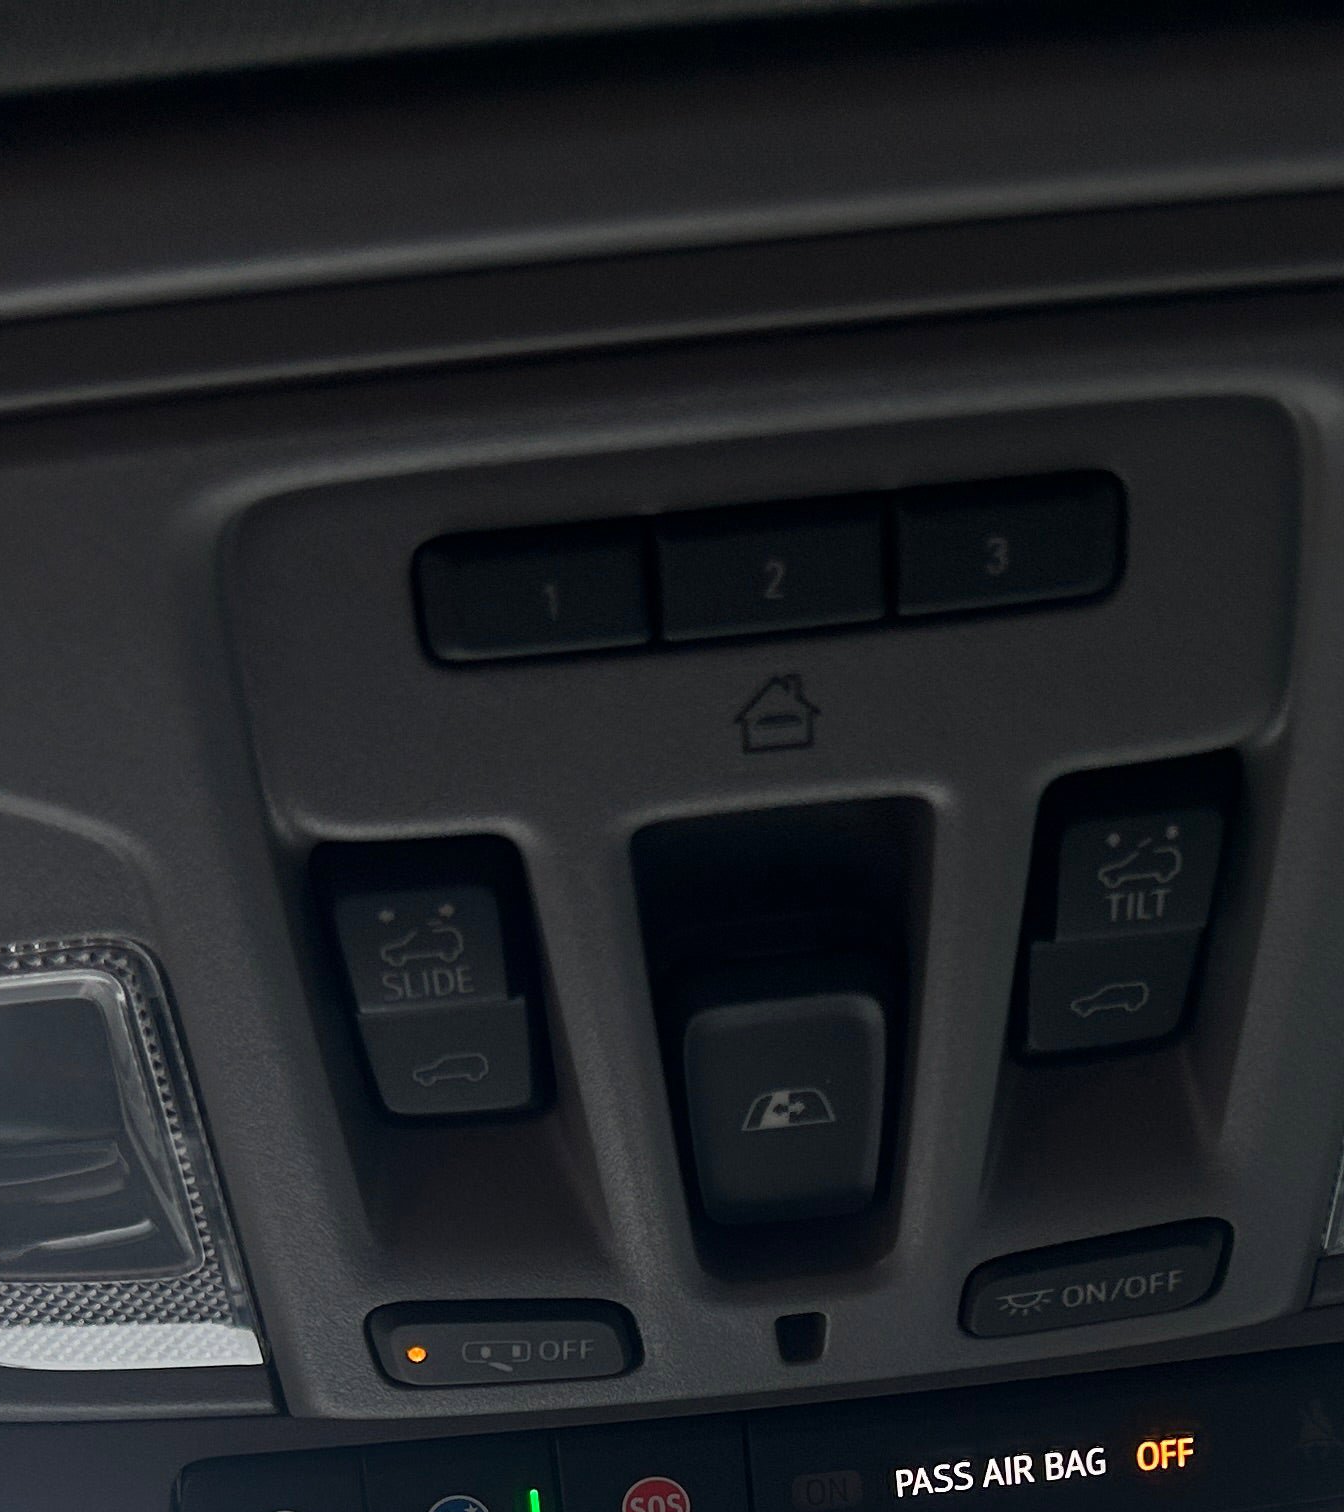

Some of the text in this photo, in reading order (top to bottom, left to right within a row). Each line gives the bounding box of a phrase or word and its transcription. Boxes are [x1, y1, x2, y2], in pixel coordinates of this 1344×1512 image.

[986, 536, 1010, 577] 3
[764, 559, 785, 600] 2
[544, 583, 560, 621] 1
[1105, 888, 1173, 923] TILT
[381, 965, 476, 1002] SLIDE
[1061, 1269, 1185, 1309] ON/OFF
[538, 1339, 595, 1362] OFF
[805, 1437, 1195, 1506] ON PASS AIR BAG OFF
